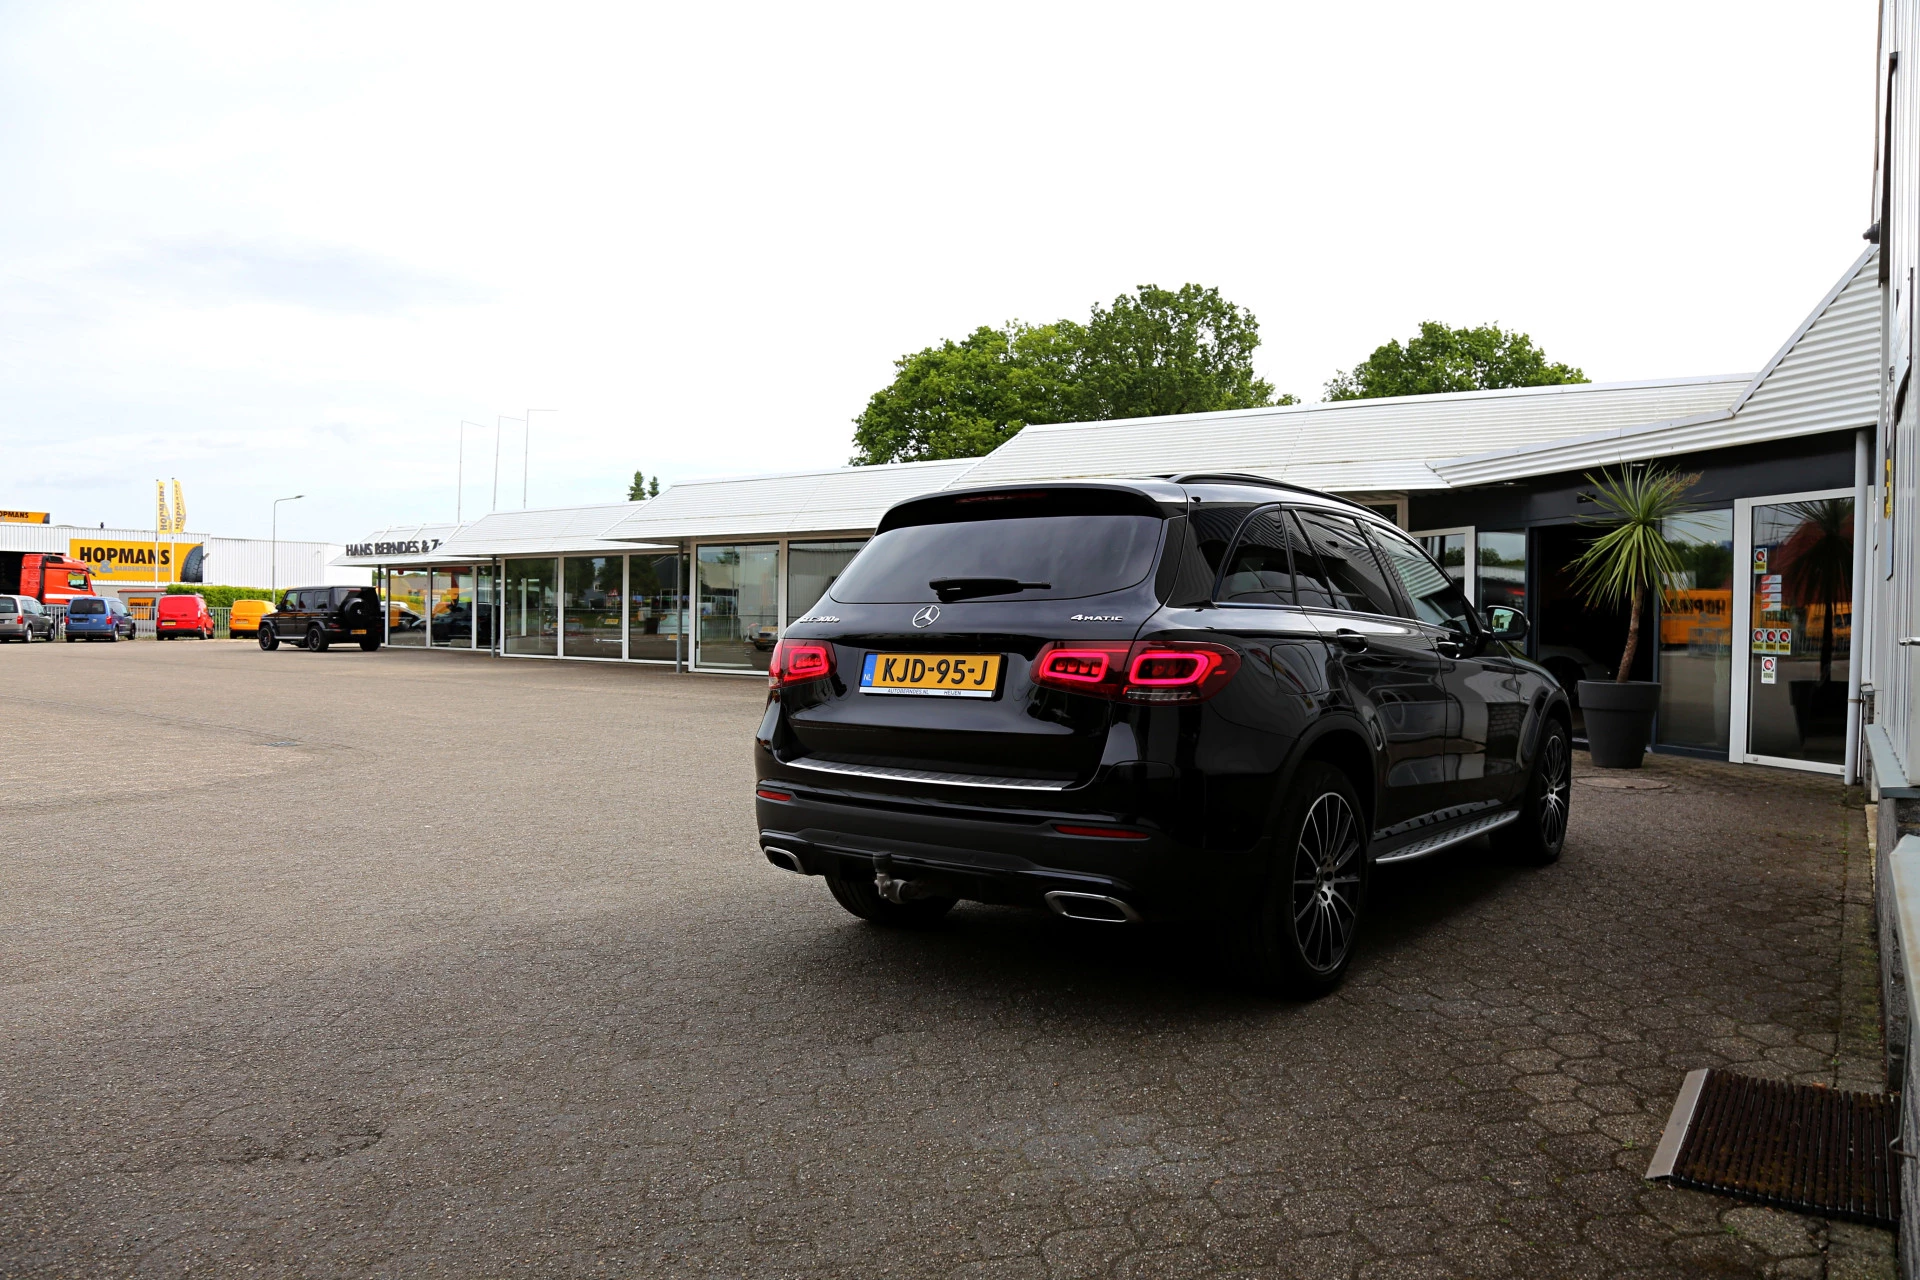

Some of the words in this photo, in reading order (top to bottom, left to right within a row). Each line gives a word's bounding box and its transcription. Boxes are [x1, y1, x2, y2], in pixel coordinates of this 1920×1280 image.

[80, 547, 170, 565] HOPMANS
[345, 543, 373, 556] HANS
[375, 541, 419, 555] BERNDES
[421, 540, 430, 552] &
[882, 658, 989, 685] KJD-95-J
